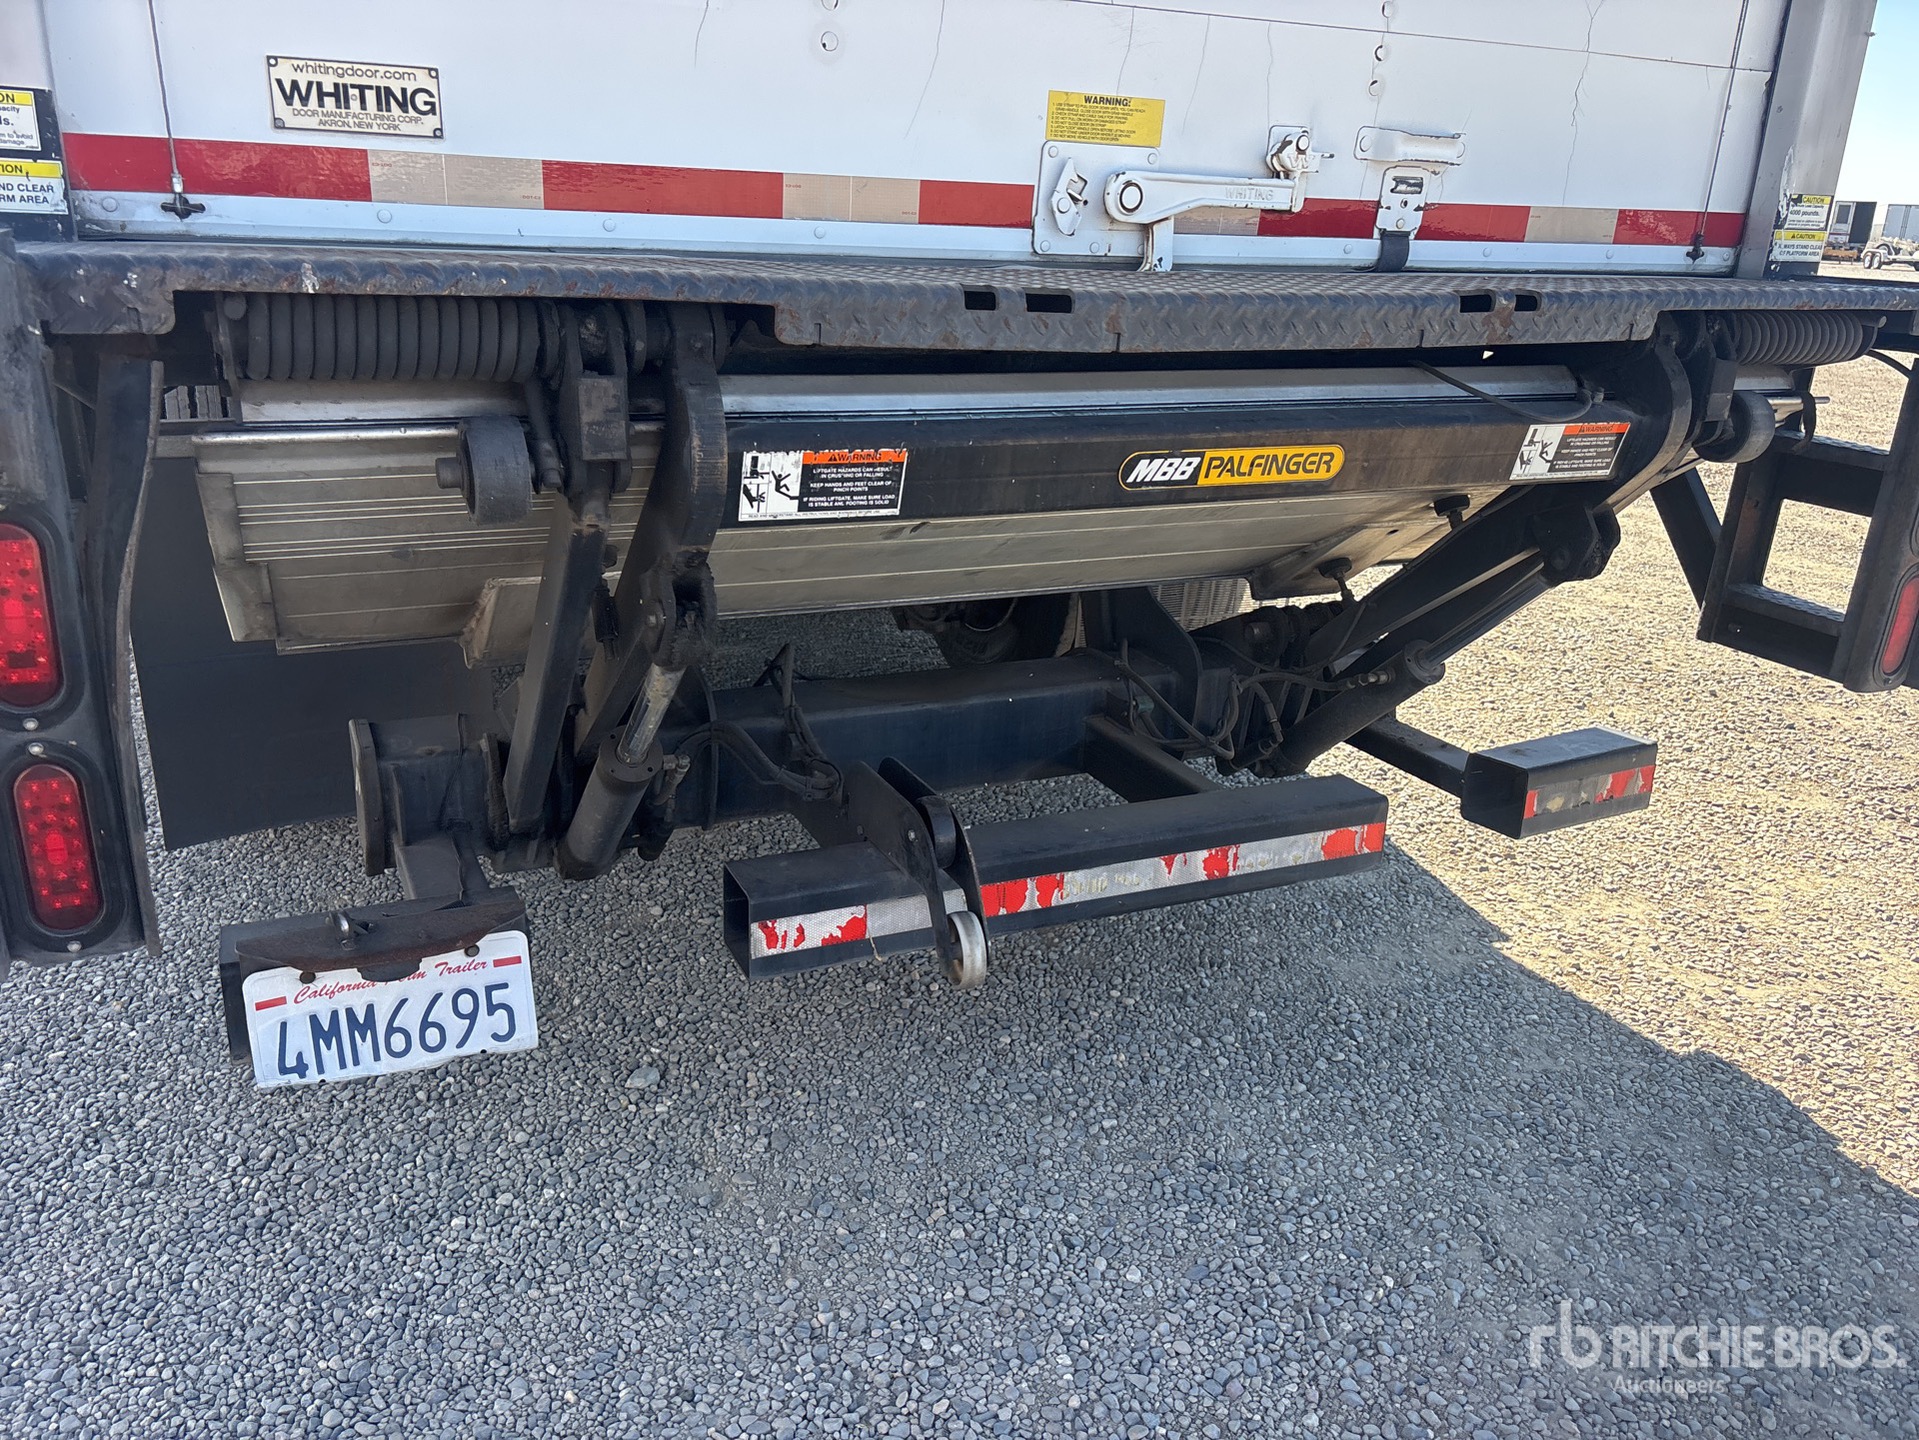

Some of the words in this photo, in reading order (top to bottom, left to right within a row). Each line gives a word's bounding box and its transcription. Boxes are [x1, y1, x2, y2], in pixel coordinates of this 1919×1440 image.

[292, 62, 417, 82] whitingdoor.com
[275, 78, 437, 116] WHITING
[1084, 95, 1131, 107] WARNING:
[293, 108, 319, 118] DOOR
[321, 110, 395, 122] MANUFACTURING
[397, 115, 424, 125] CORP.
[353, 121, 373, 129] NEW
[376, 122, 401, 131] YORK
[0, 164, 22, 173] ION
[17, 184, 54, 193] CLEAR
[1225, 187, 1274, 200] WHITING
[20, 195, 49, 204] AREA
[839, 453, 882, 462] WARNING
[1126, 457, 1201, 483] MBB
[1204, 452, 1334, 478] PALFINGER
[294, 979, 377, 1004] California
[434, 959, 488, 976] Trailer
[278, 982, 516, 1079] 4MM6695
